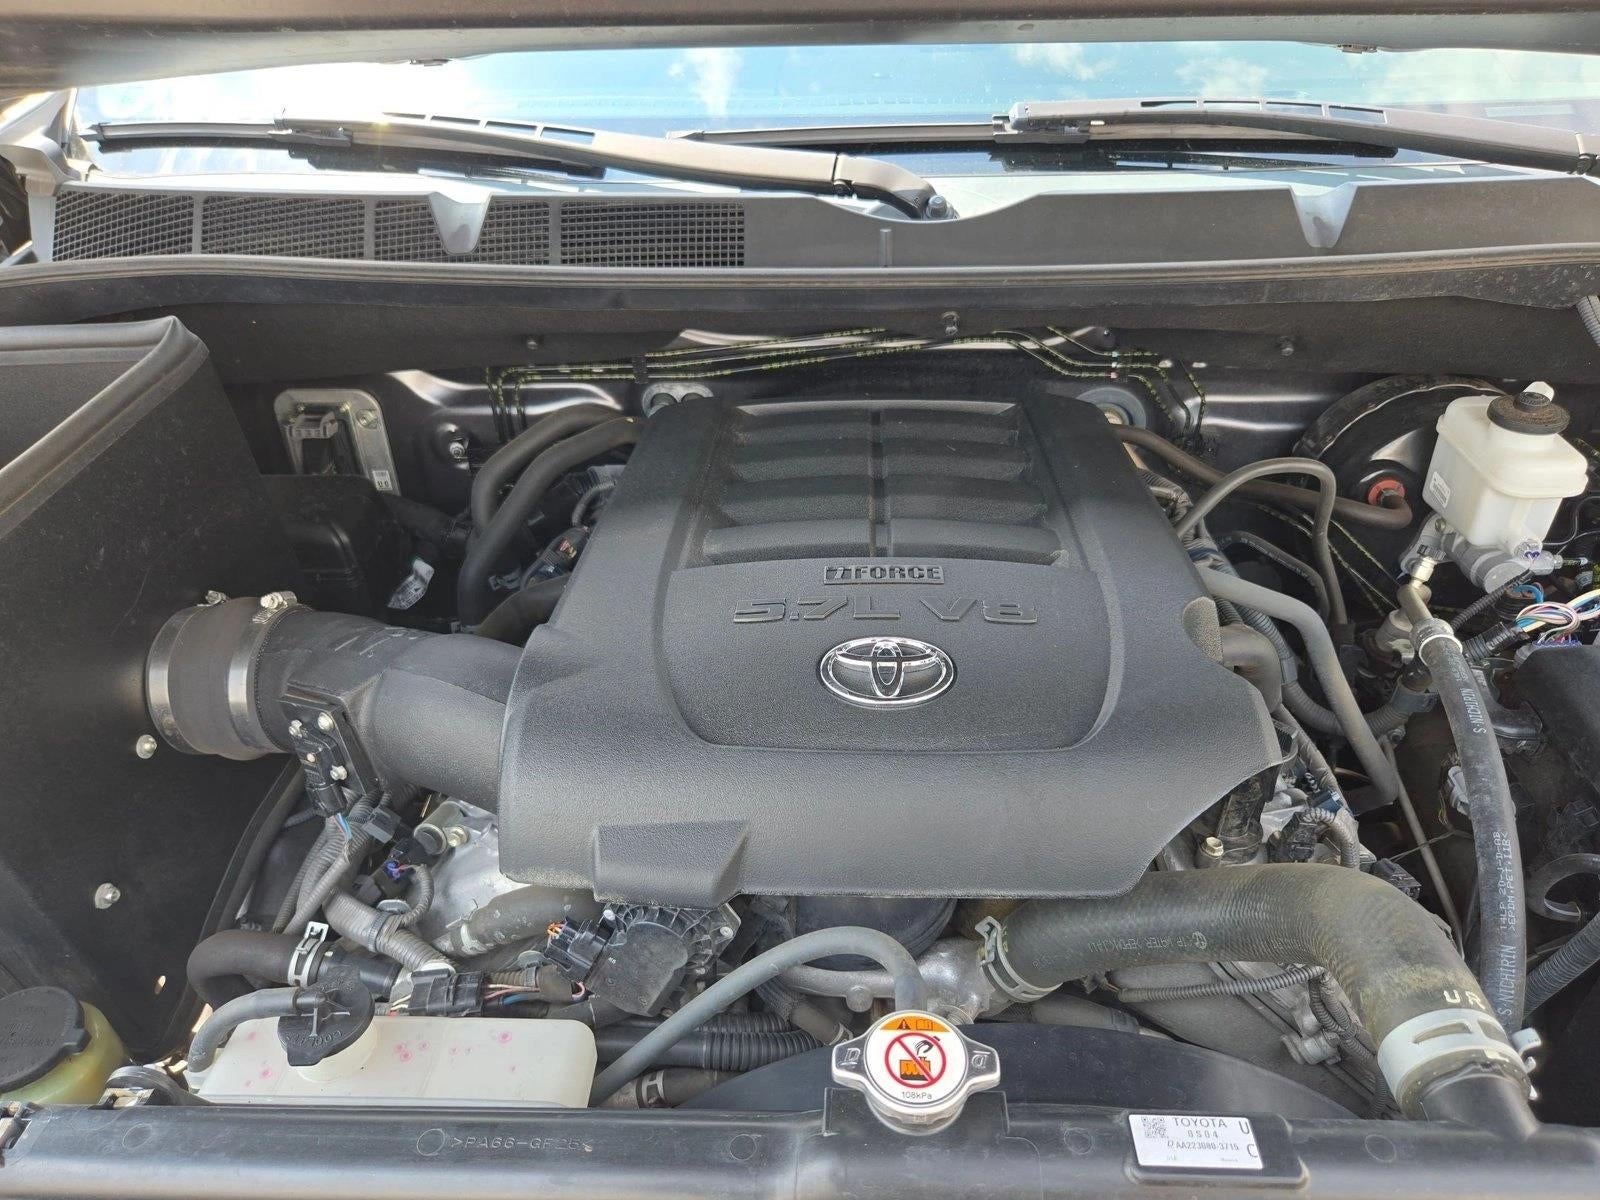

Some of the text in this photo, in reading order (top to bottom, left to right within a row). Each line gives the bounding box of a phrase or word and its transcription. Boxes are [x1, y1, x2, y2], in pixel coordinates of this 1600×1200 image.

[733, 597, 1038, 624] 5.7L V8
[902, 1091, 932, 1100] 108kPa
[1174, 1117, 1228, 1128] TOYOTA
[1238, 1120, 1251, 1135] U
[1246, 1143, 1259, 1158] C
